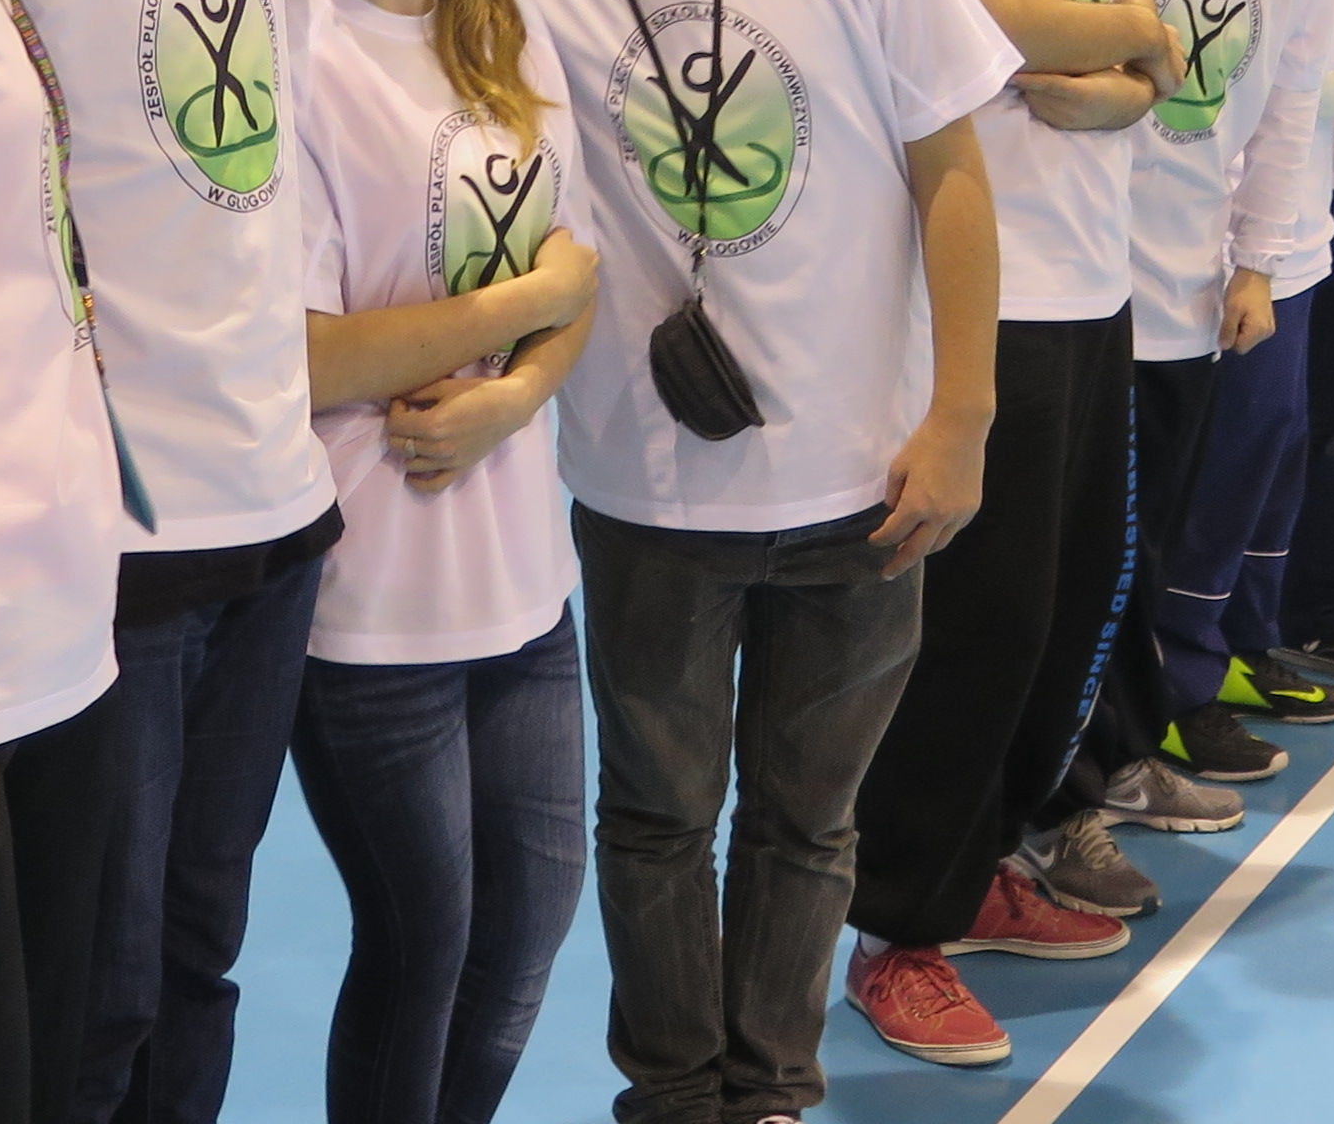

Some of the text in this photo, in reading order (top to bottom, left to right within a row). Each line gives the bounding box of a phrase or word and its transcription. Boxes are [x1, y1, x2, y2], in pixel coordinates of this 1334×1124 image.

[140, 49, 164, 121] ZESPÓŁ
[207, 184, 224, 202] W
[693, 221, 778, 255] OGOWIE
[1077, 622, 1119, 718] SINCE
